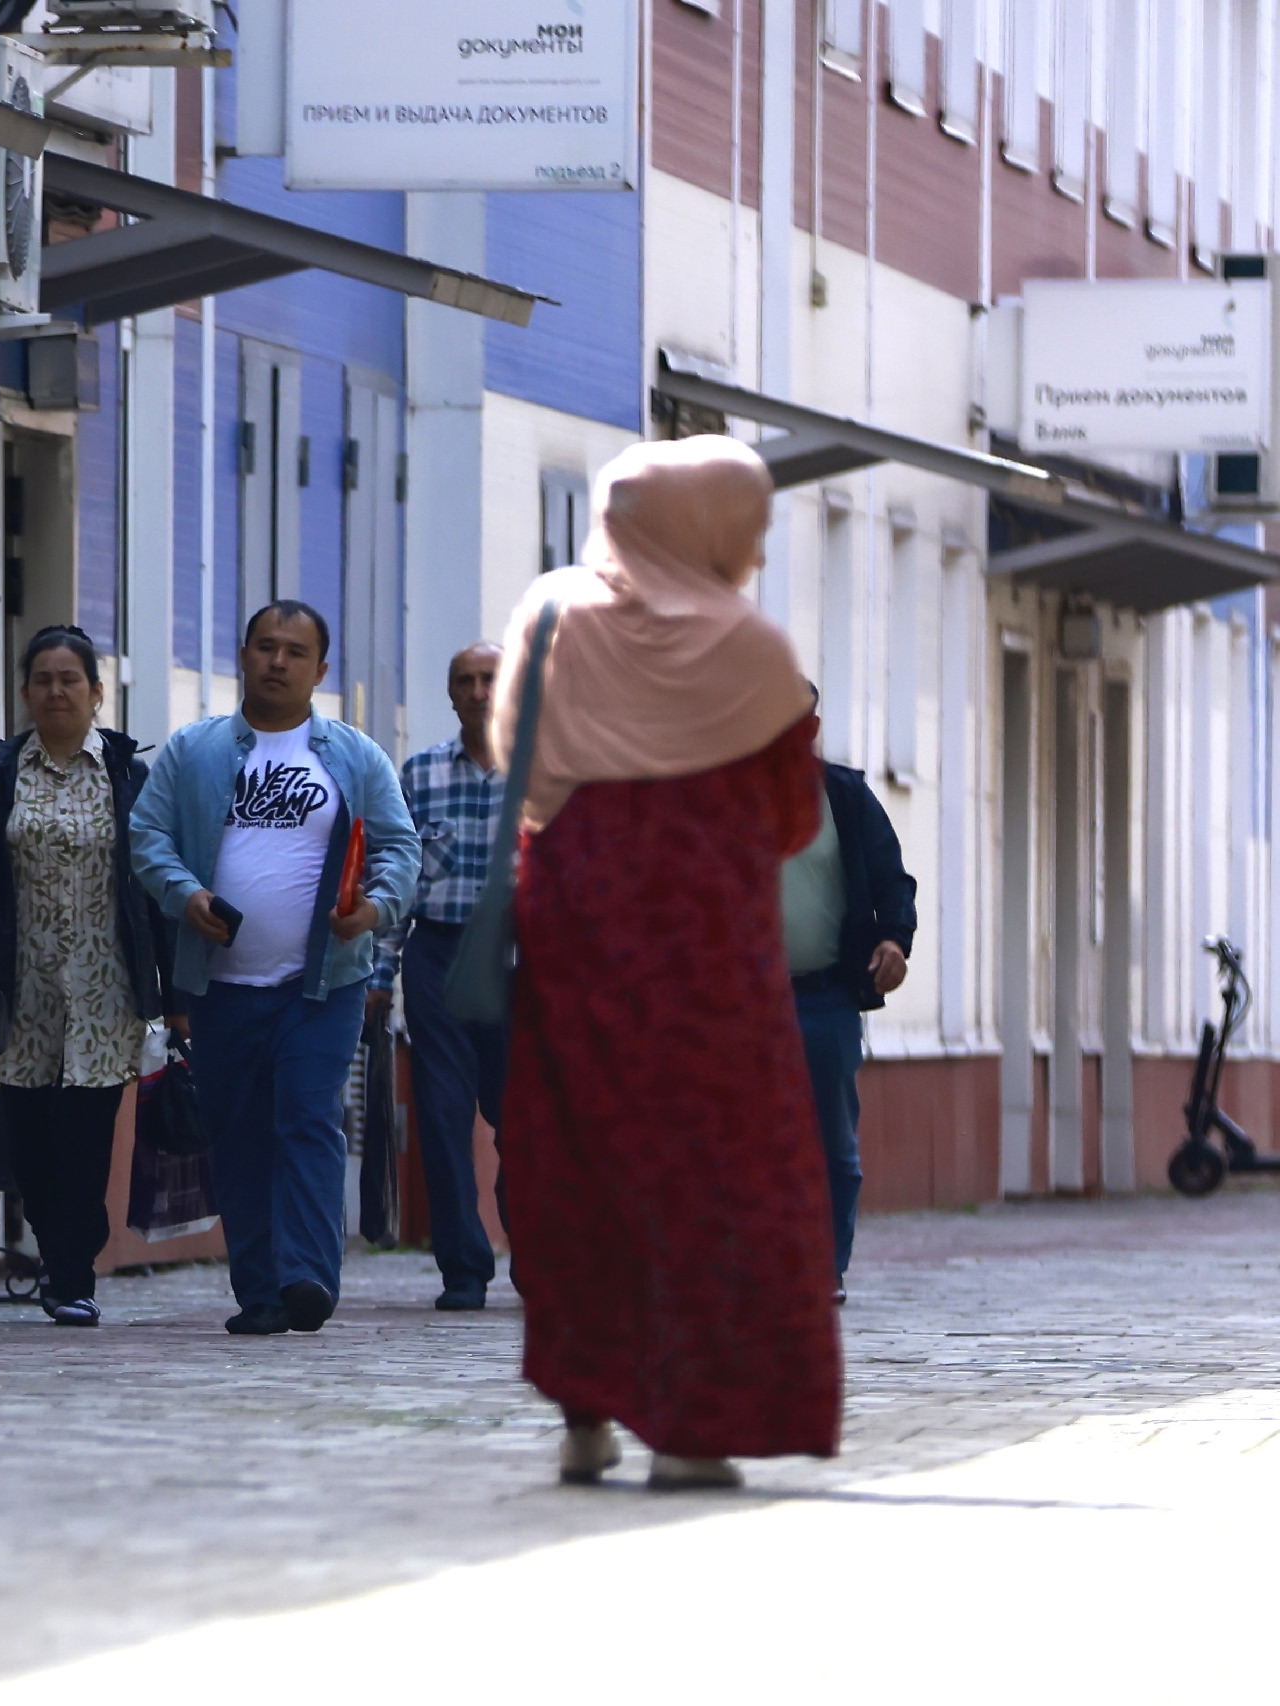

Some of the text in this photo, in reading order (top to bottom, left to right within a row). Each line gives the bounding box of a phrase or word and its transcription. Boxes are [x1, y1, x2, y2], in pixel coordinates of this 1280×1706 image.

[375, 104, 391, 123] И
[395, 104, 474, 126] ВЫДАЧА
[477, 104, 609, 126] ДОКУМЕНТОВ
[610, 162, 621, 178] 2
[237, 820, 272, 829] SUMMER
[274, 821, 298, 829] CAMP
